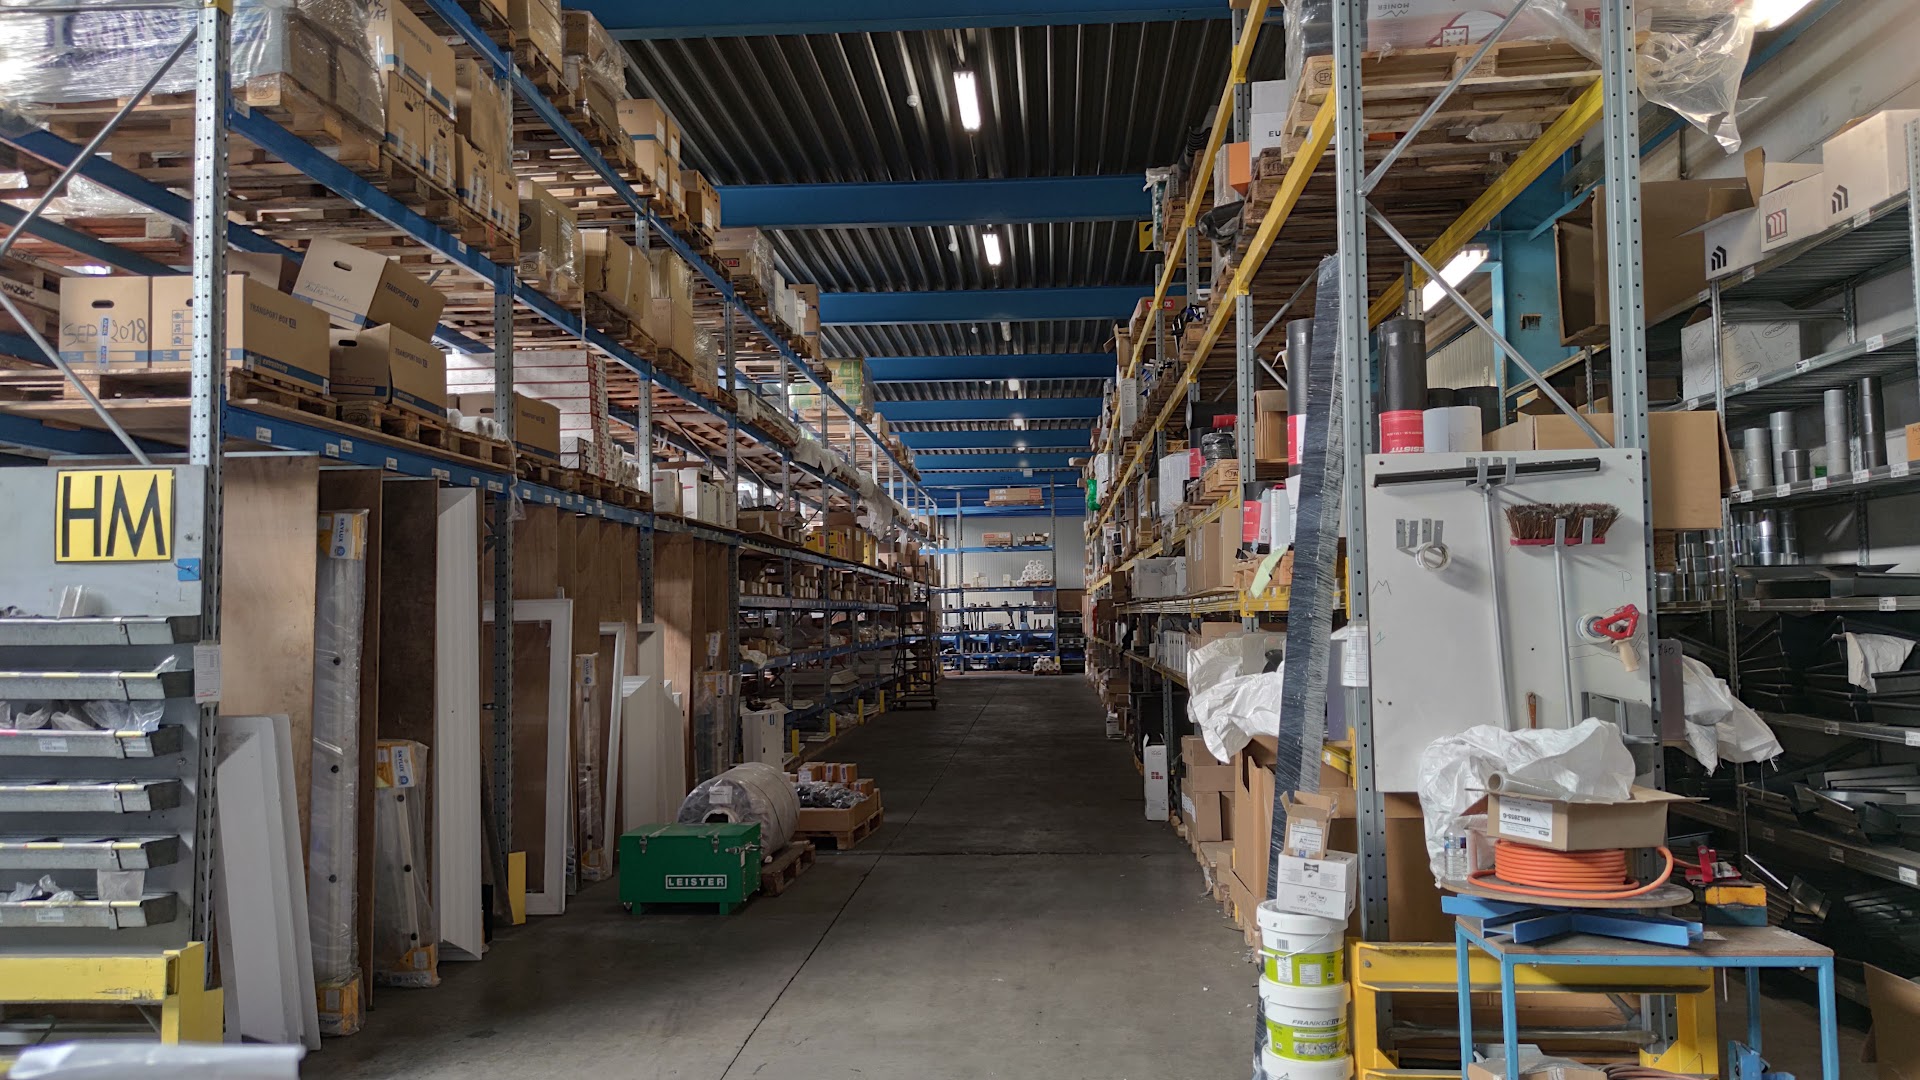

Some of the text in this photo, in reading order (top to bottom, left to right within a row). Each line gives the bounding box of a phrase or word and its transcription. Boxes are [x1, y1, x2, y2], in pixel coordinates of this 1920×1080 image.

[386, 282, 407, 300] TRANSPORT
[250, 303, 289, 325] TRANSPORT BOX
[63, 317, 147, 346] SEP 2018
[395, 347, 415, 362] TRANSPORT
[62, 474, 166, 557] HM
[668, 877, 724, 887] LEISTER
